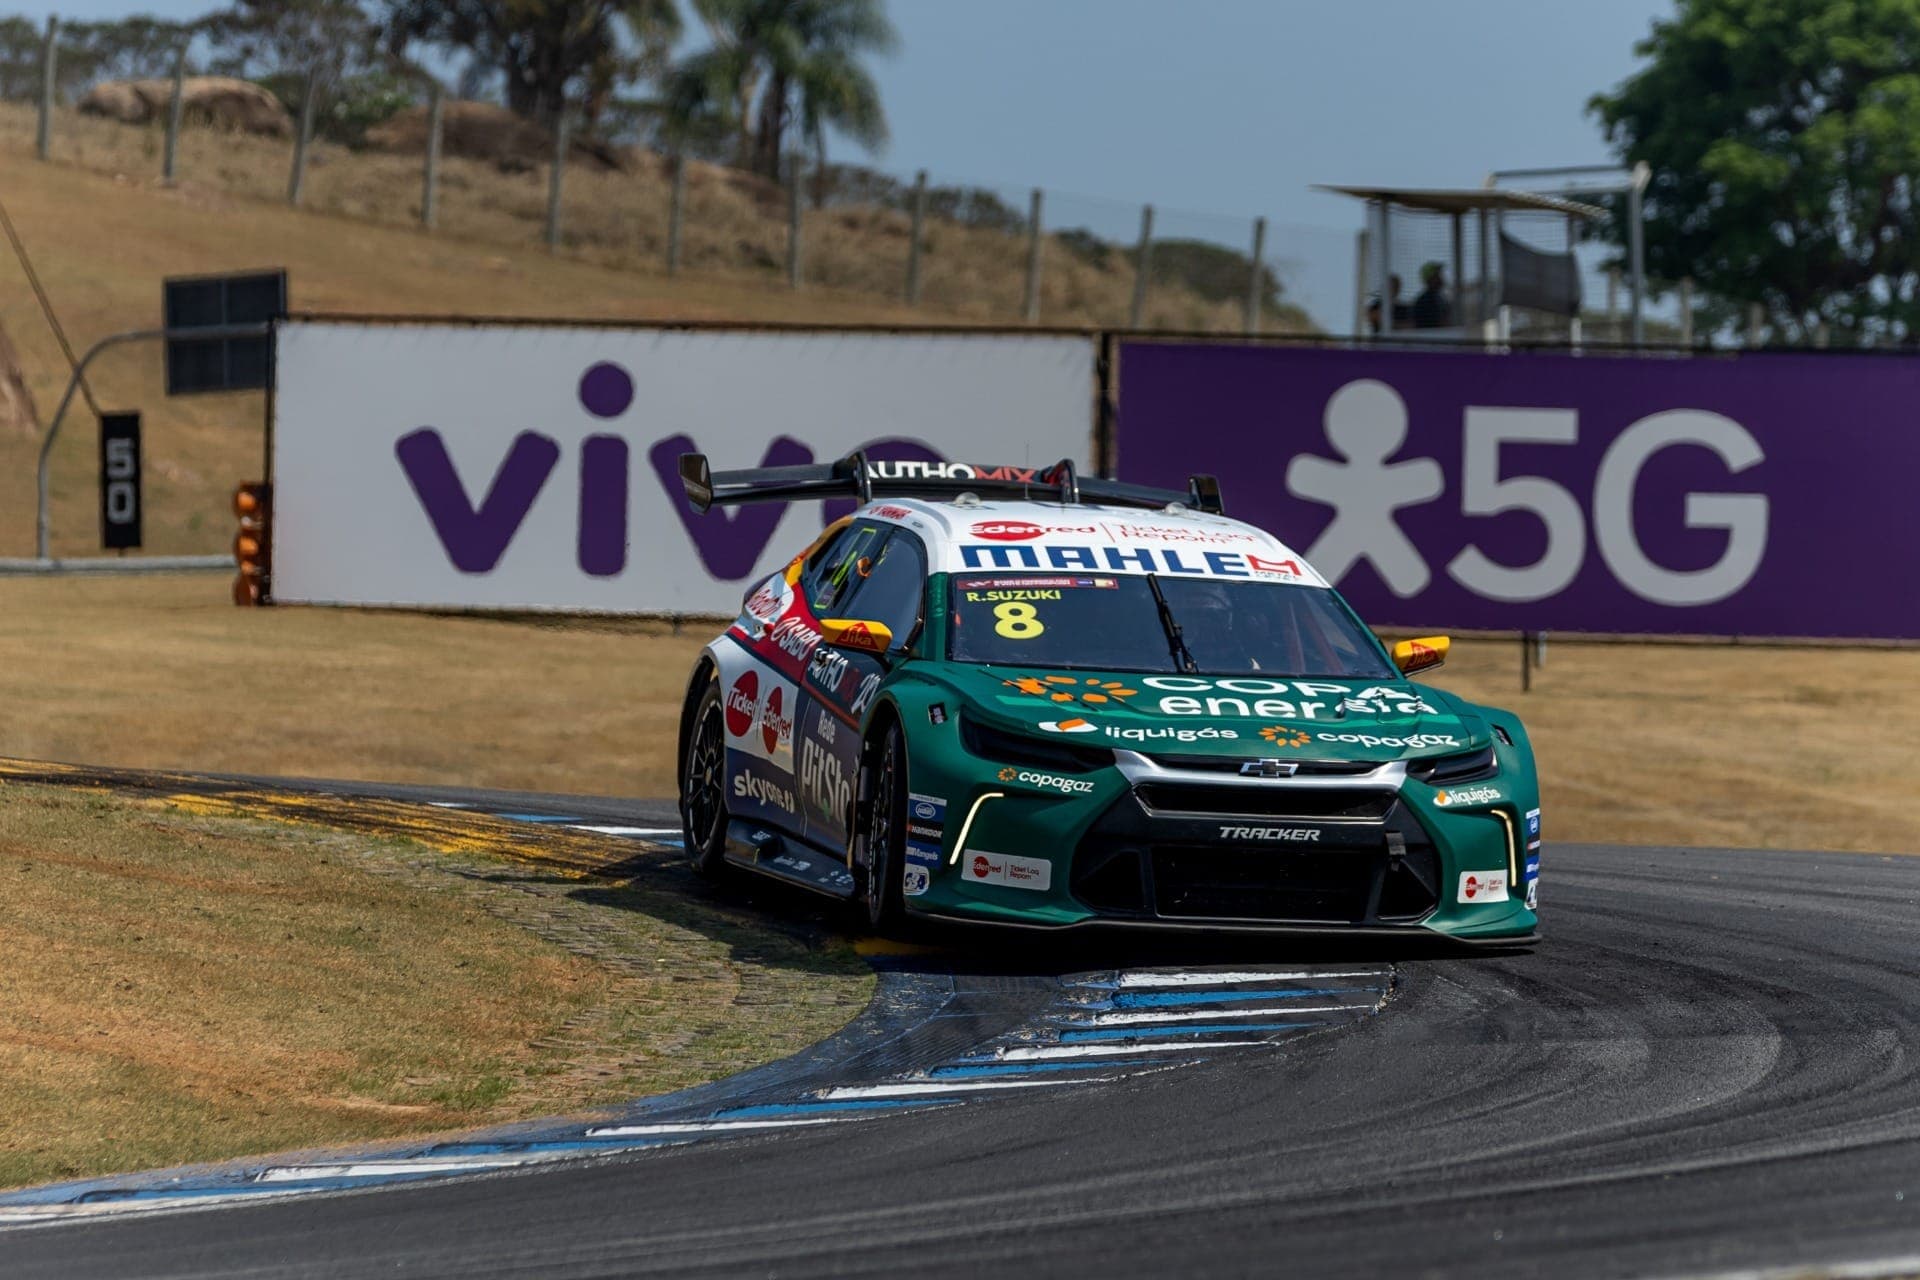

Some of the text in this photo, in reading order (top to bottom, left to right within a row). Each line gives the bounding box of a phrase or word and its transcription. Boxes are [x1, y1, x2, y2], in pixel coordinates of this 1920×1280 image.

[106, 437, 135, 524] 50
[1445, 405, 1770, 607] 5G
[969, 523, 1097, 536] Edenred
[959, 545, 1250, 577] MAHLE
[966, 590, 1062, 602] R.SUZUKI
[993, 601, 1044, 639] 8
[841, 625, 872, 645] Sika
[1142, 677, 1420, 699] COPA
[727, 687, 760, 722] Ticket
[818, 709, 836, 745] Rede
[1105, 726, 1461, 748] liquigás copagaz
[802, 737, 850, 831] PitSto
[1018, 770, 1095, 793] copagaz
[1449, 786, 1501, 805] liquigás
[1219, 826, 1321, 841] TRACKER
[973, 860, 1002, 874] Edenred
